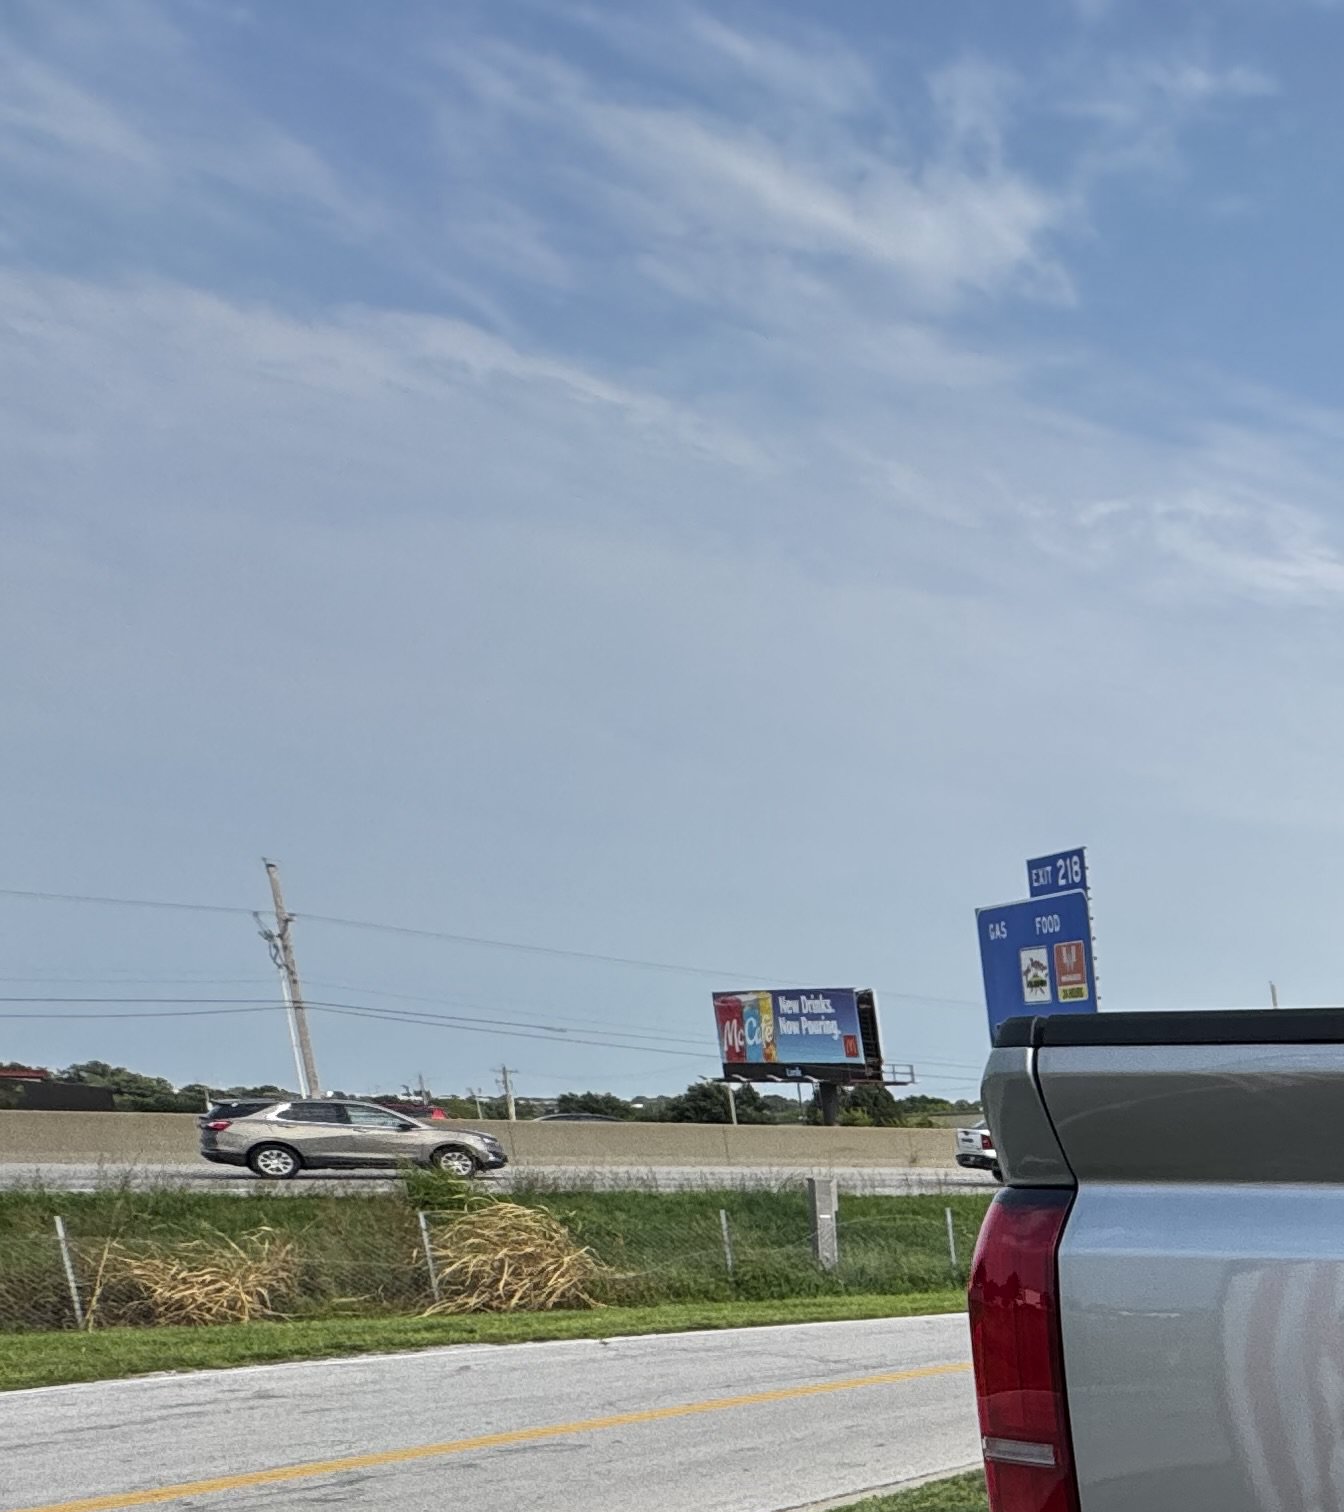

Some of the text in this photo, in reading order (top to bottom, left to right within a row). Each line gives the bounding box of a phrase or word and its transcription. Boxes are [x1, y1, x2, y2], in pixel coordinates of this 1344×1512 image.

[1031, 855, 1082, 887] EXIT 218
[988, 920, 1008, 941] GAS
[1035, 914, 1061, 935] FOOD
[778, 995, 800, 1014] New
[778, 1016, 800, 1035] Now
